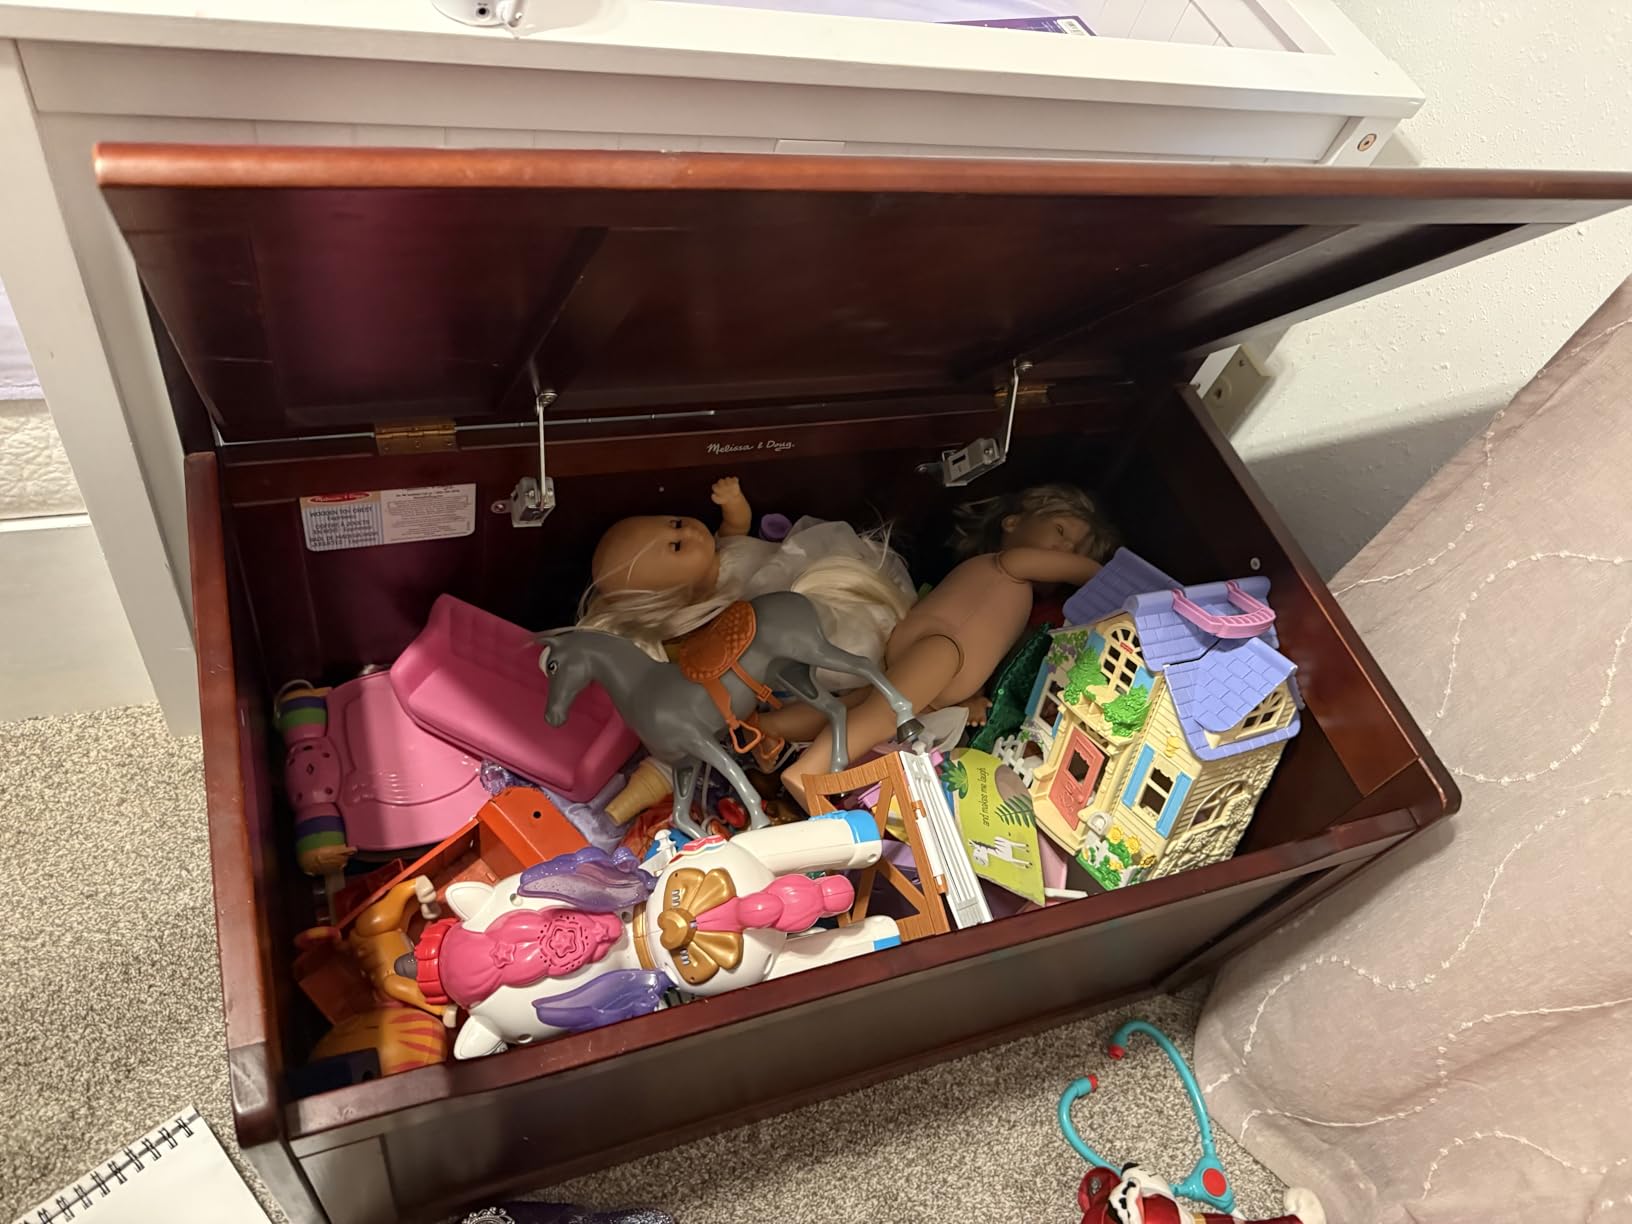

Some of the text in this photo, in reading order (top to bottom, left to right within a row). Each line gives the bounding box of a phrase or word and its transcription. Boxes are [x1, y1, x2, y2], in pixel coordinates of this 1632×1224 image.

[706, 442, 754, 455] Melissa
[976, 767, 990, 827] and makes me laugh
